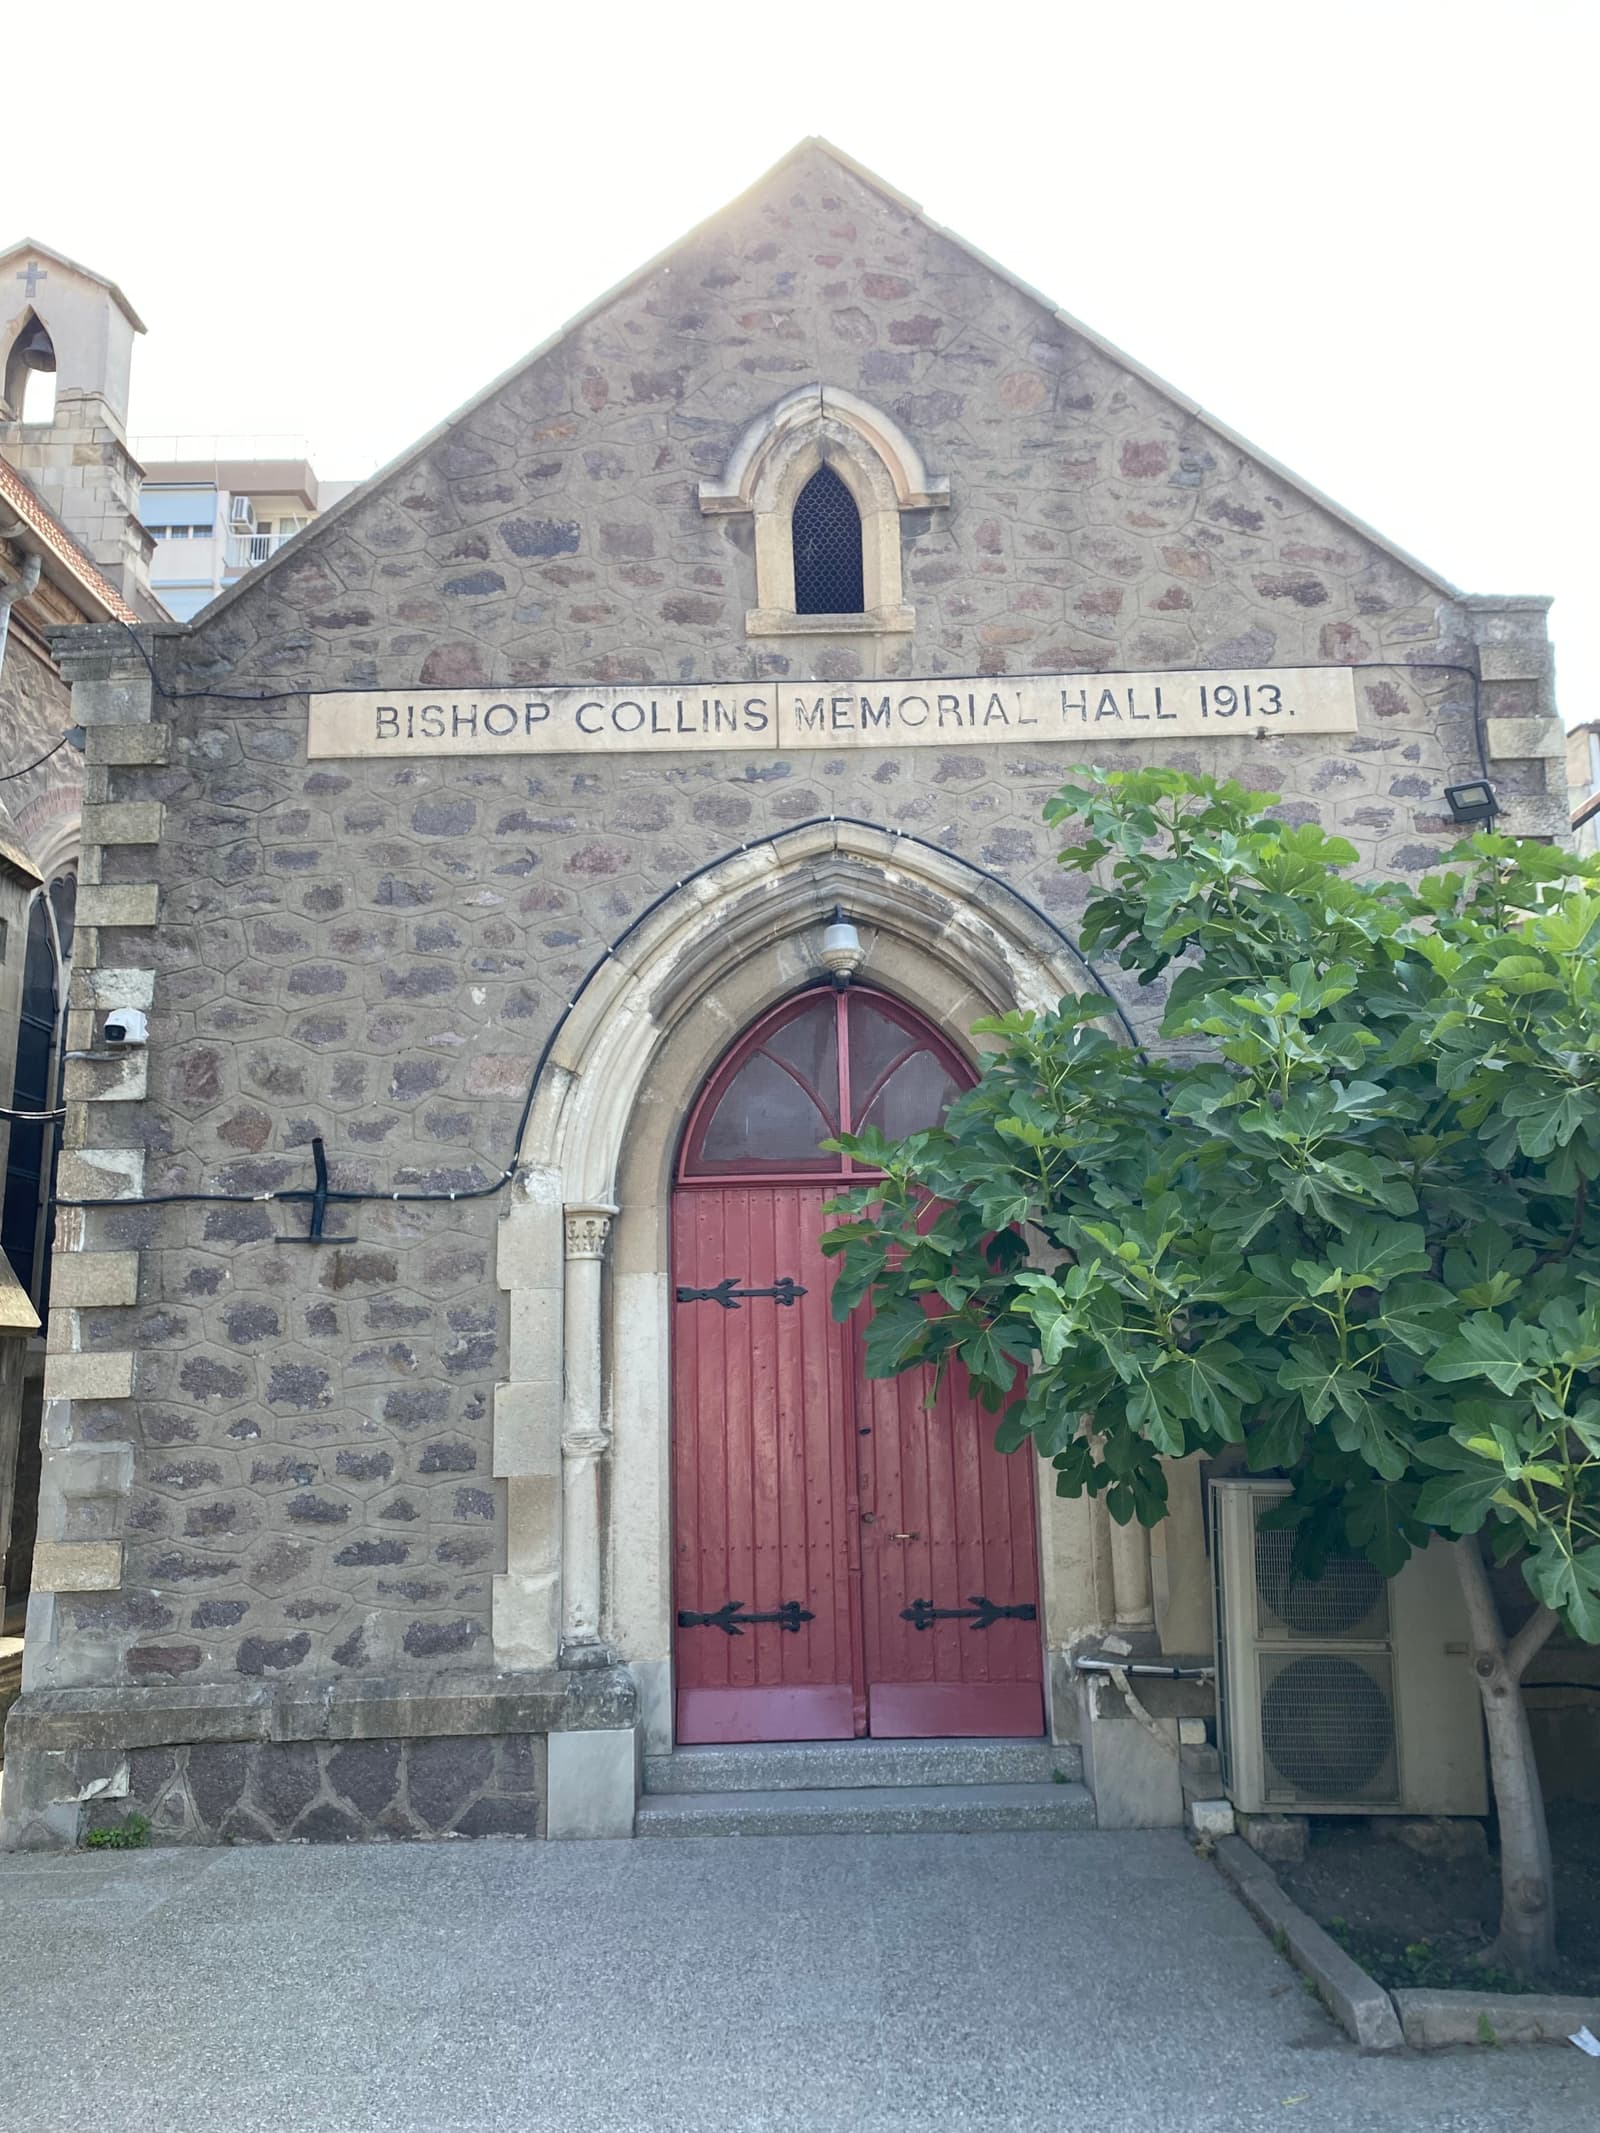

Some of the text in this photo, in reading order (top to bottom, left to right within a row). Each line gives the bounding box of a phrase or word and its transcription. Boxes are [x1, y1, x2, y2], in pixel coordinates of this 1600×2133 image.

[376, 684, 1296, 739] BISHOP COLLINS MEMORIAL HALL 1913.
